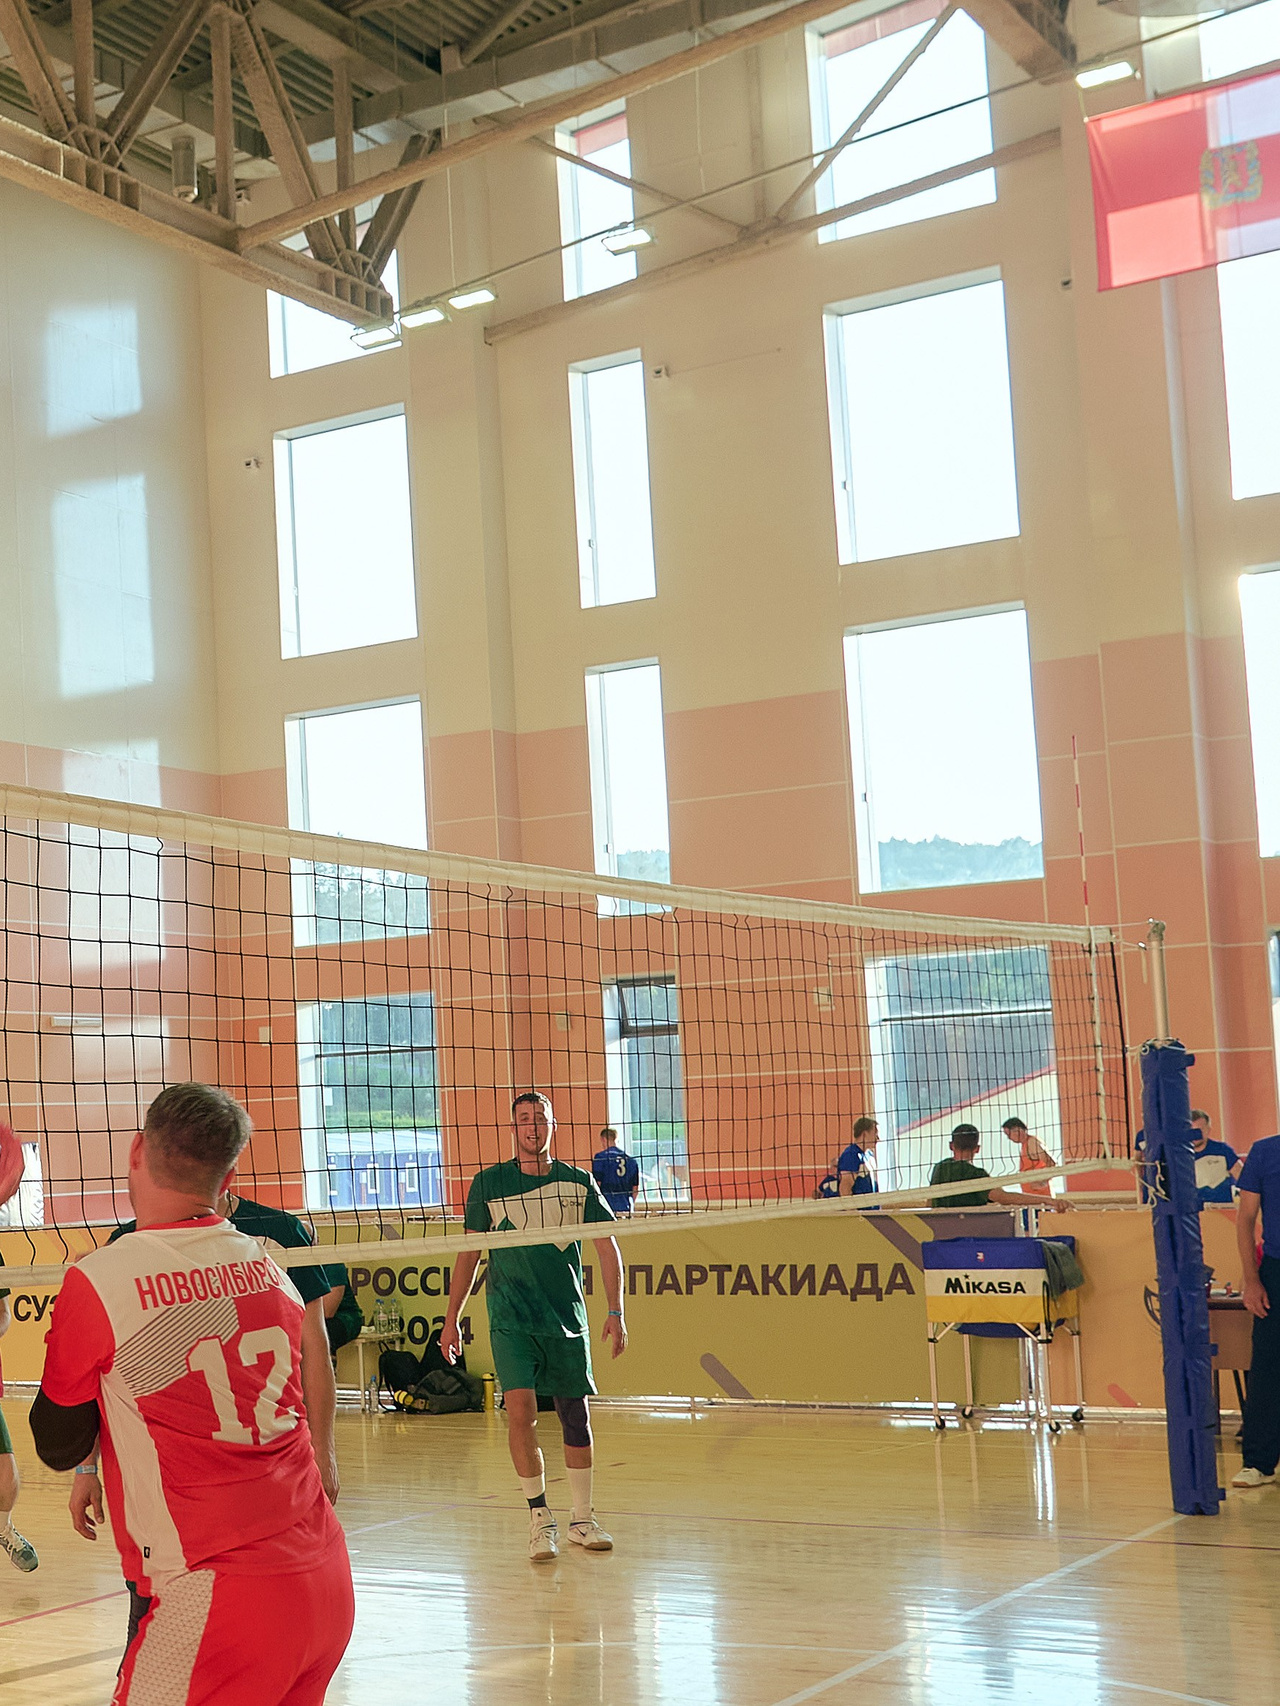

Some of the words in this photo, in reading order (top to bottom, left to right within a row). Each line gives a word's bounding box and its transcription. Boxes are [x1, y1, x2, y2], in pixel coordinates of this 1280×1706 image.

[616, 1156, 626, 1177] 3
[623, 1263, 916, 1301] ПАРТАКИАДА
[187, 1325, 300, 1445] 12
